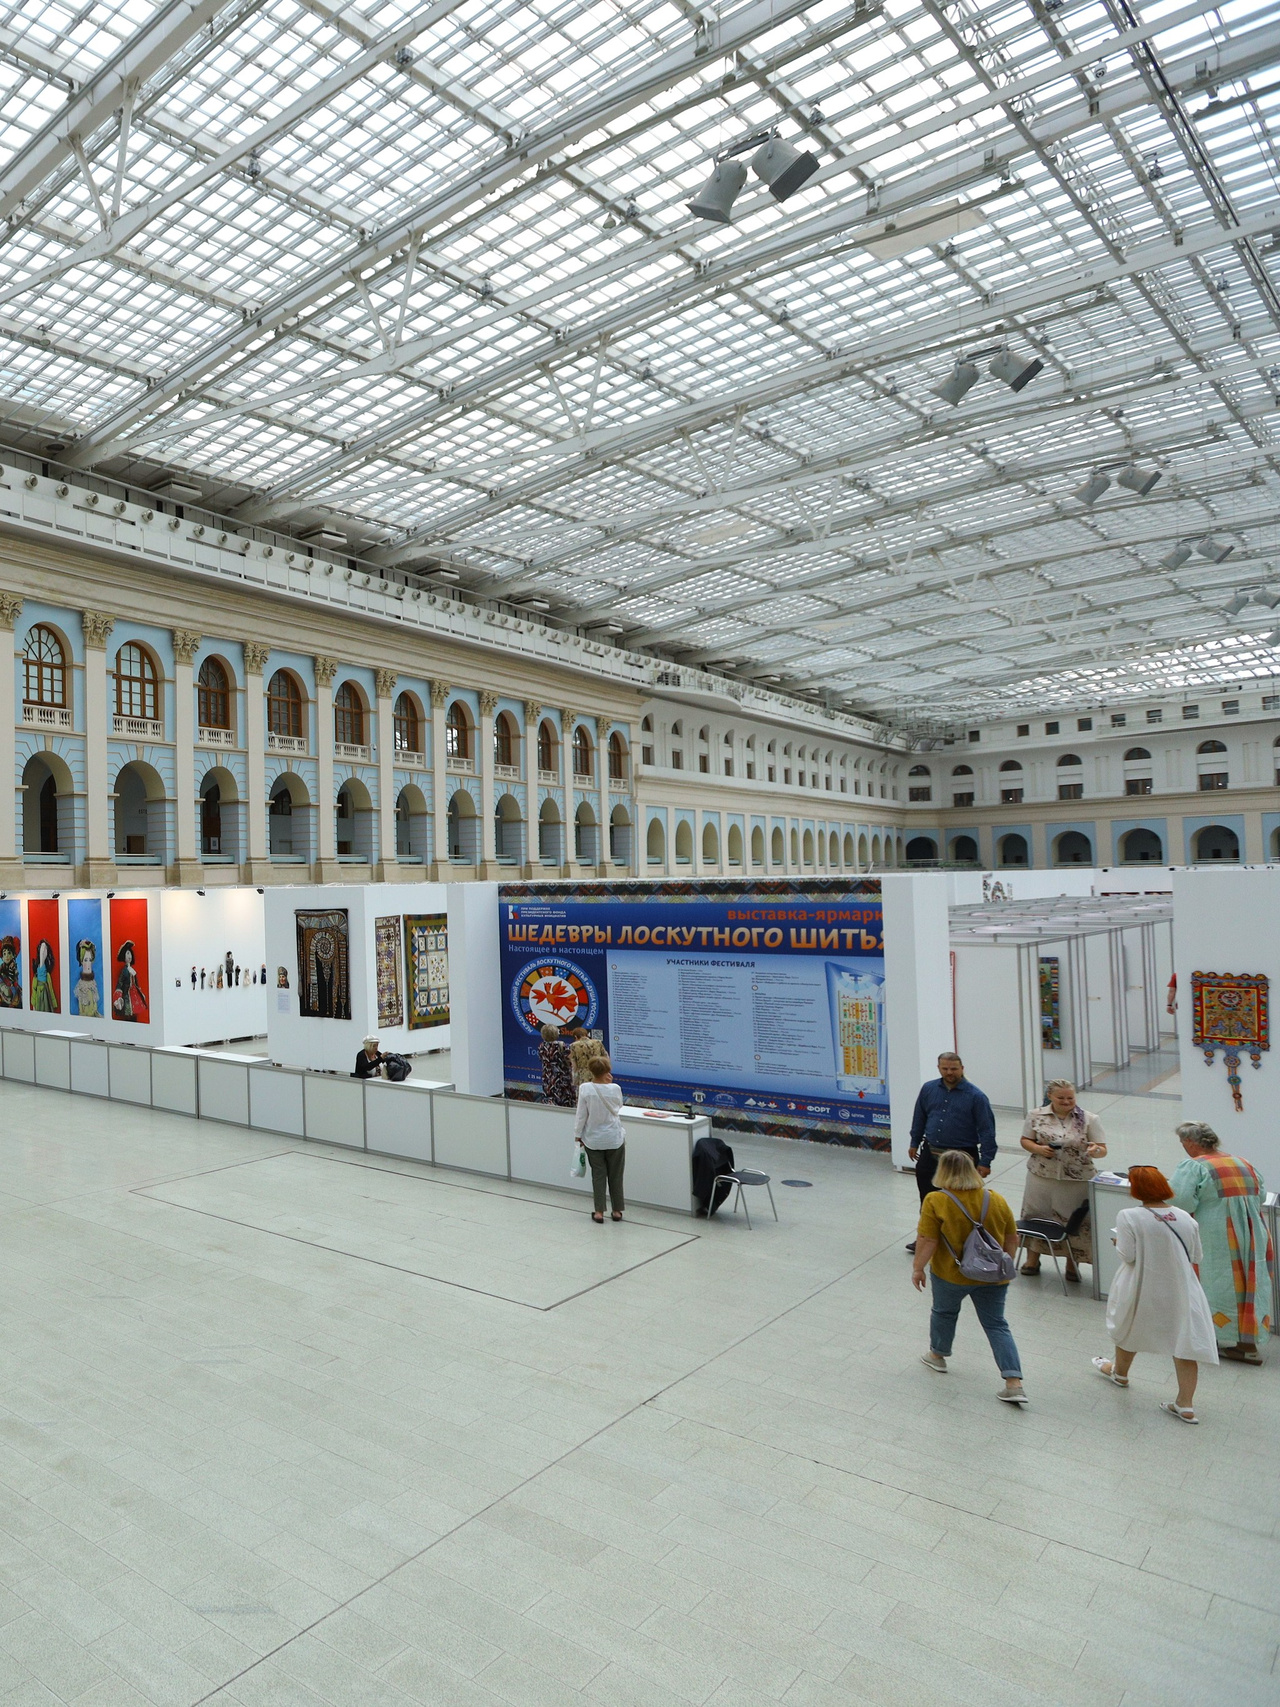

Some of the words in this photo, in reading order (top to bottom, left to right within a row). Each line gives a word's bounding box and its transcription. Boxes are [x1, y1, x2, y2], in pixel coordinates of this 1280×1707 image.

[727, 910, 883, 924] выставка-ярмарк
[508, 924, 612, 945] ШЕДЕВРЫ
[617, 925, 784, 947] ЛОСКУТНОГО
[509, 944, 550, 953] Настоящее
[559, 947, 604, 955] настоящем
[536, 958, 571, 967] ЛОСКУТНОГО
[666, 958, 709, 966] УЧАСТНИКИ
[710, 959, 755, 968] ФЕСТИВАЛЯ
